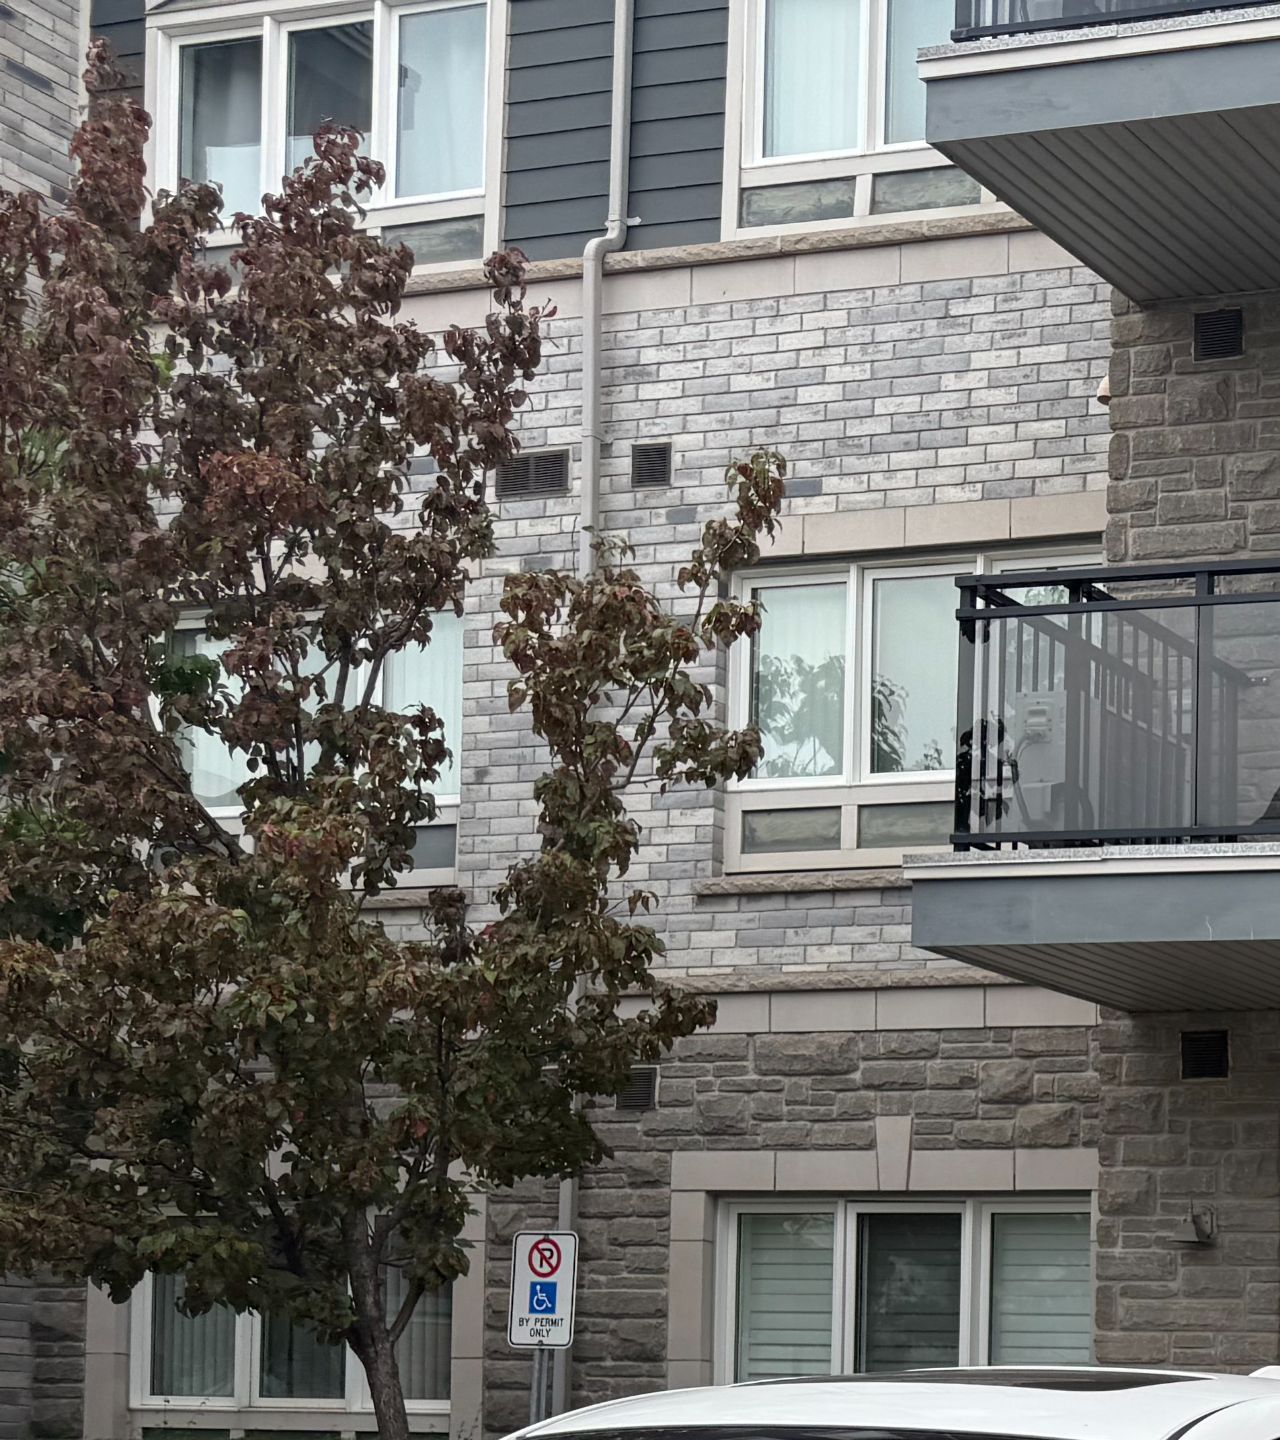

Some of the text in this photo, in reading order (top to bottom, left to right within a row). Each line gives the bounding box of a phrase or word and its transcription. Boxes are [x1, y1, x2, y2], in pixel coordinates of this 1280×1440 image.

[518, 1317, 564, 1328] BY PERMIT
[529, 1328, 552, 1338] ONLY
